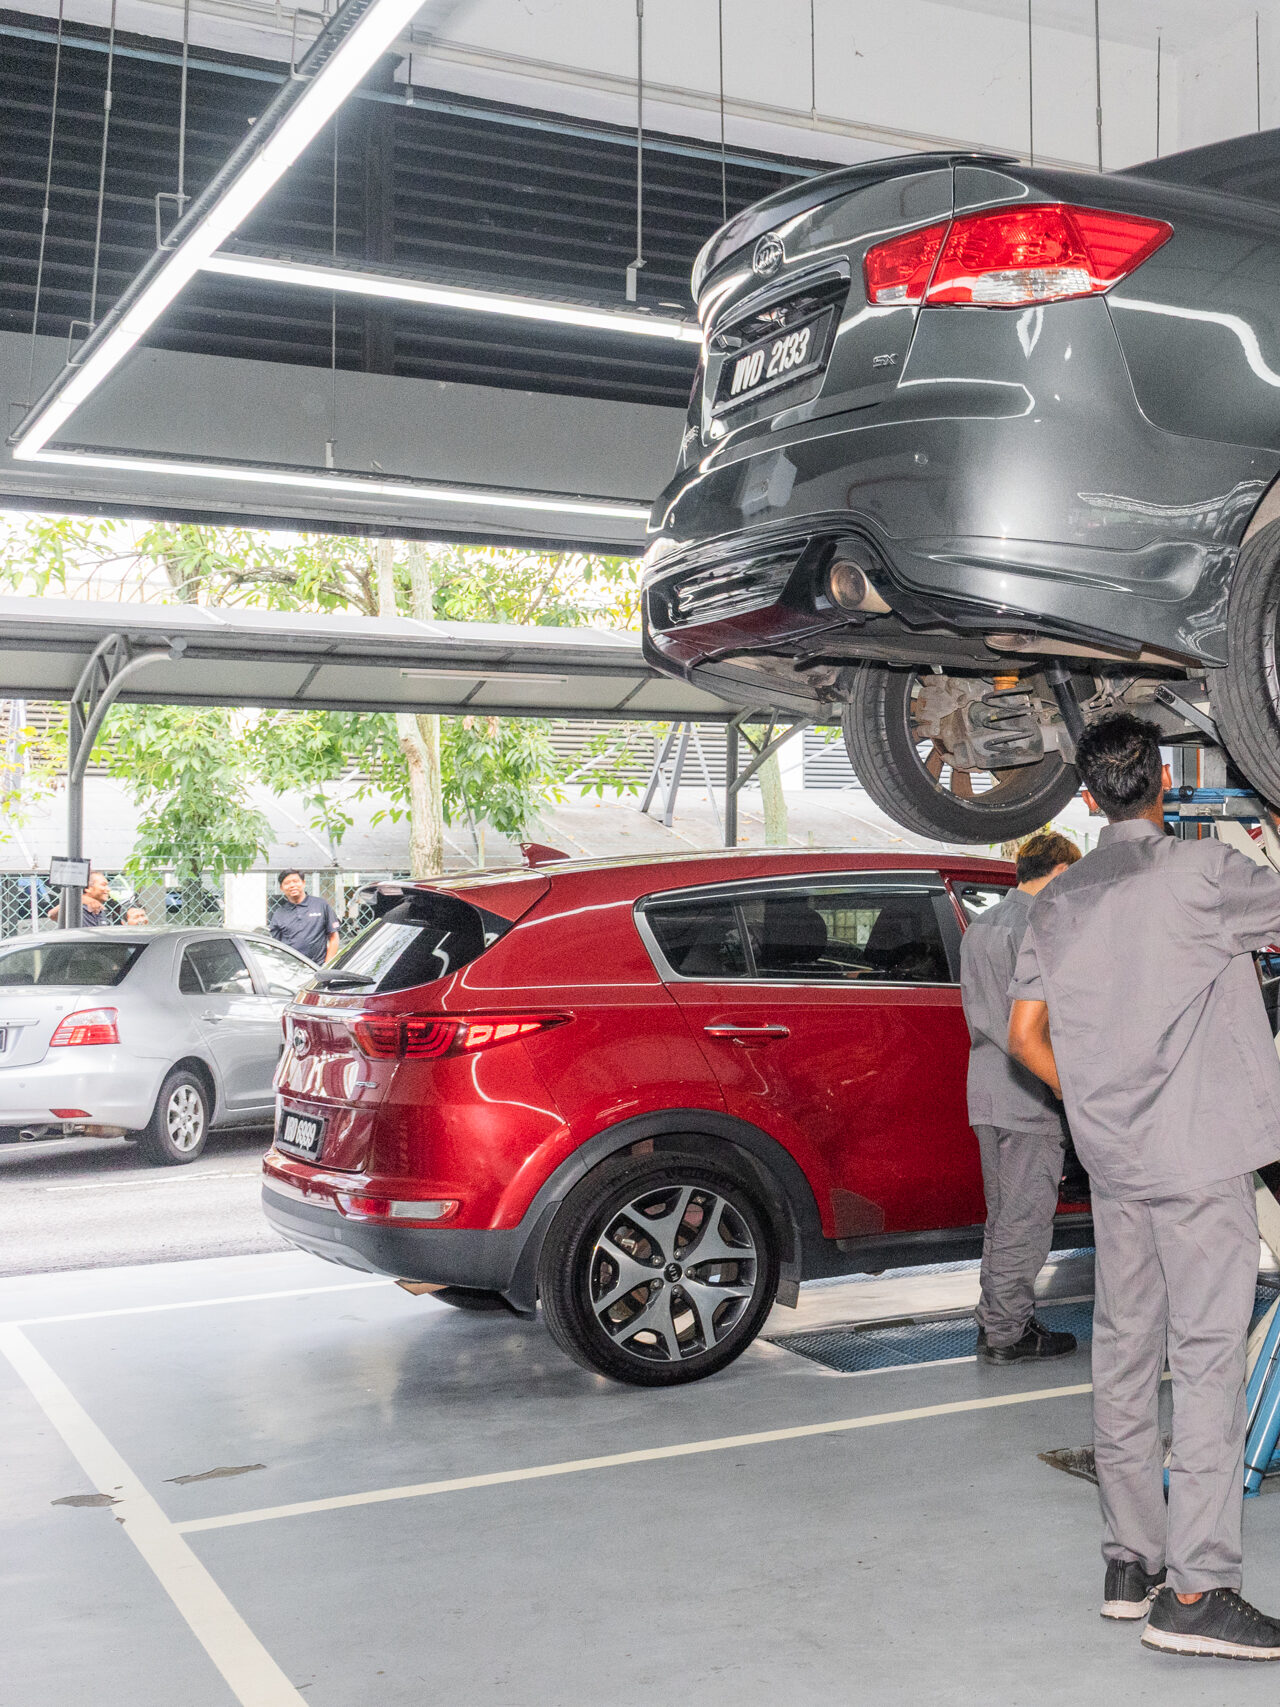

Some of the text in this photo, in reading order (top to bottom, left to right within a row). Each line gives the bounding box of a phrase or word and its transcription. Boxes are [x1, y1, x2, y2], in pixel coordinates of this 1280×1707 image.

[731, 327, 810, 395] WVD 2133
[873, 353, 899, 368] SX
